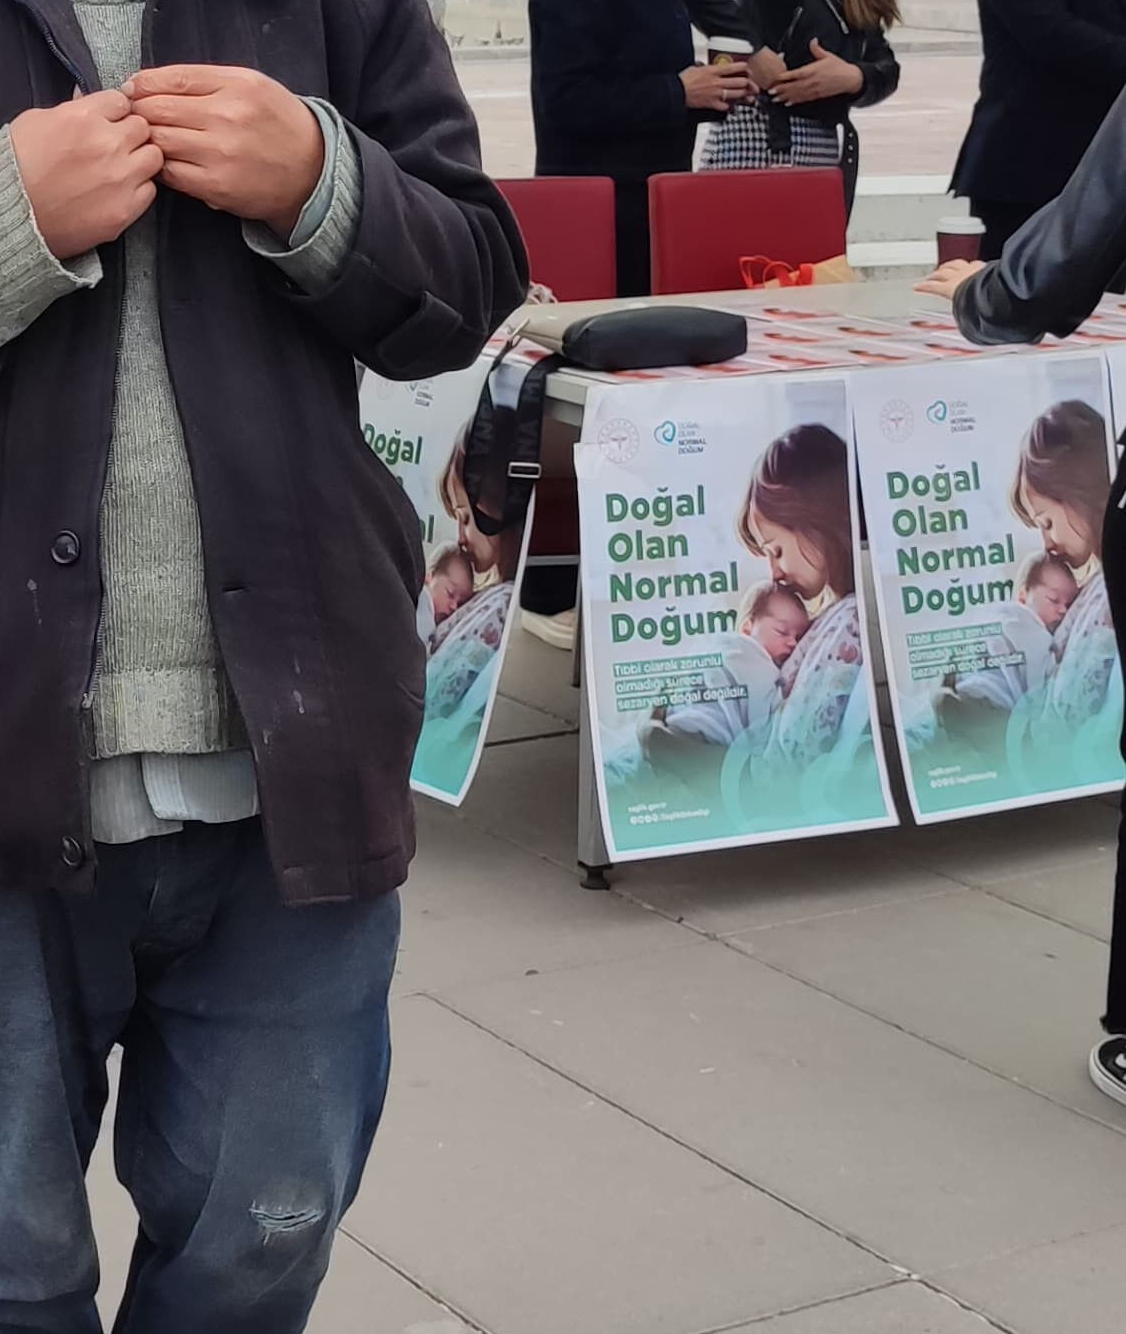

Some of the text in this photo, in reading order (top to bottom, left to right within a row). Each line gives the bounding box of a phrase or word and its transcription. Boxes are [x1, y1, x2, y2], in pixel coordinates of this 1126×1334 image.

[886, 461, 981, 501] Doğal
[605, 485, 706, 527] Doğal
[892, 504, 969, 537] Olan
[608, 529, 689, 563] Olan
[896, 533, 1016, 576] Normal
[609, 561, 739, 603] Normal
[901, 577, 1014, 616] Doğum
[611, 606, 737, 646] Doğum
